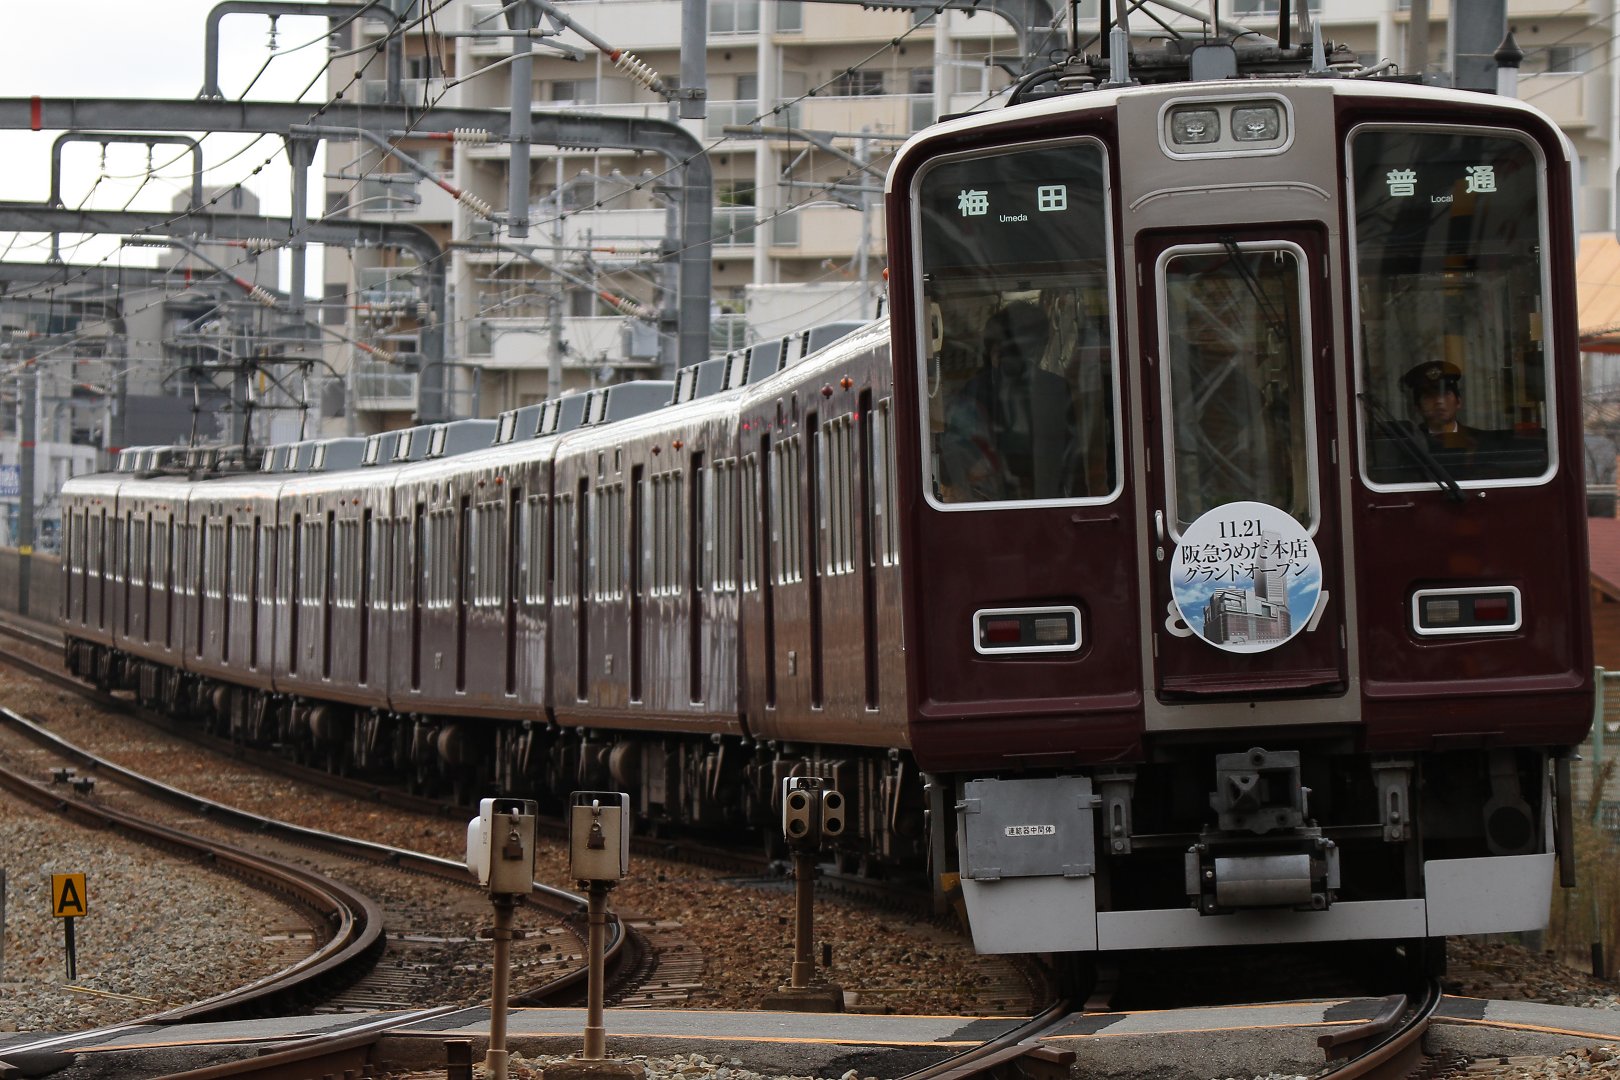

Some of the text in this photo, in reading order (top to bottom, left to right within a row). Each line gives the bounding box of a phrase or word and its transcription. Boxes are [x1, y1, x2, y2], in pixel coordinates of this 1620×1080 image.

[1386, 165, 1497, 197] 普通
[957, 184, 1067, 217] 梅田
[1431, 194, 1454, 203] Local
[999, 213, 1028, 223] Umeda
[1218, 519, 1263, 539] 11.21
[1181, 538, 1308, 565] 阪急うめだ本店
[1184, 558, 1310, 584] グランドオープン
[57, 877, 83, 913] A
